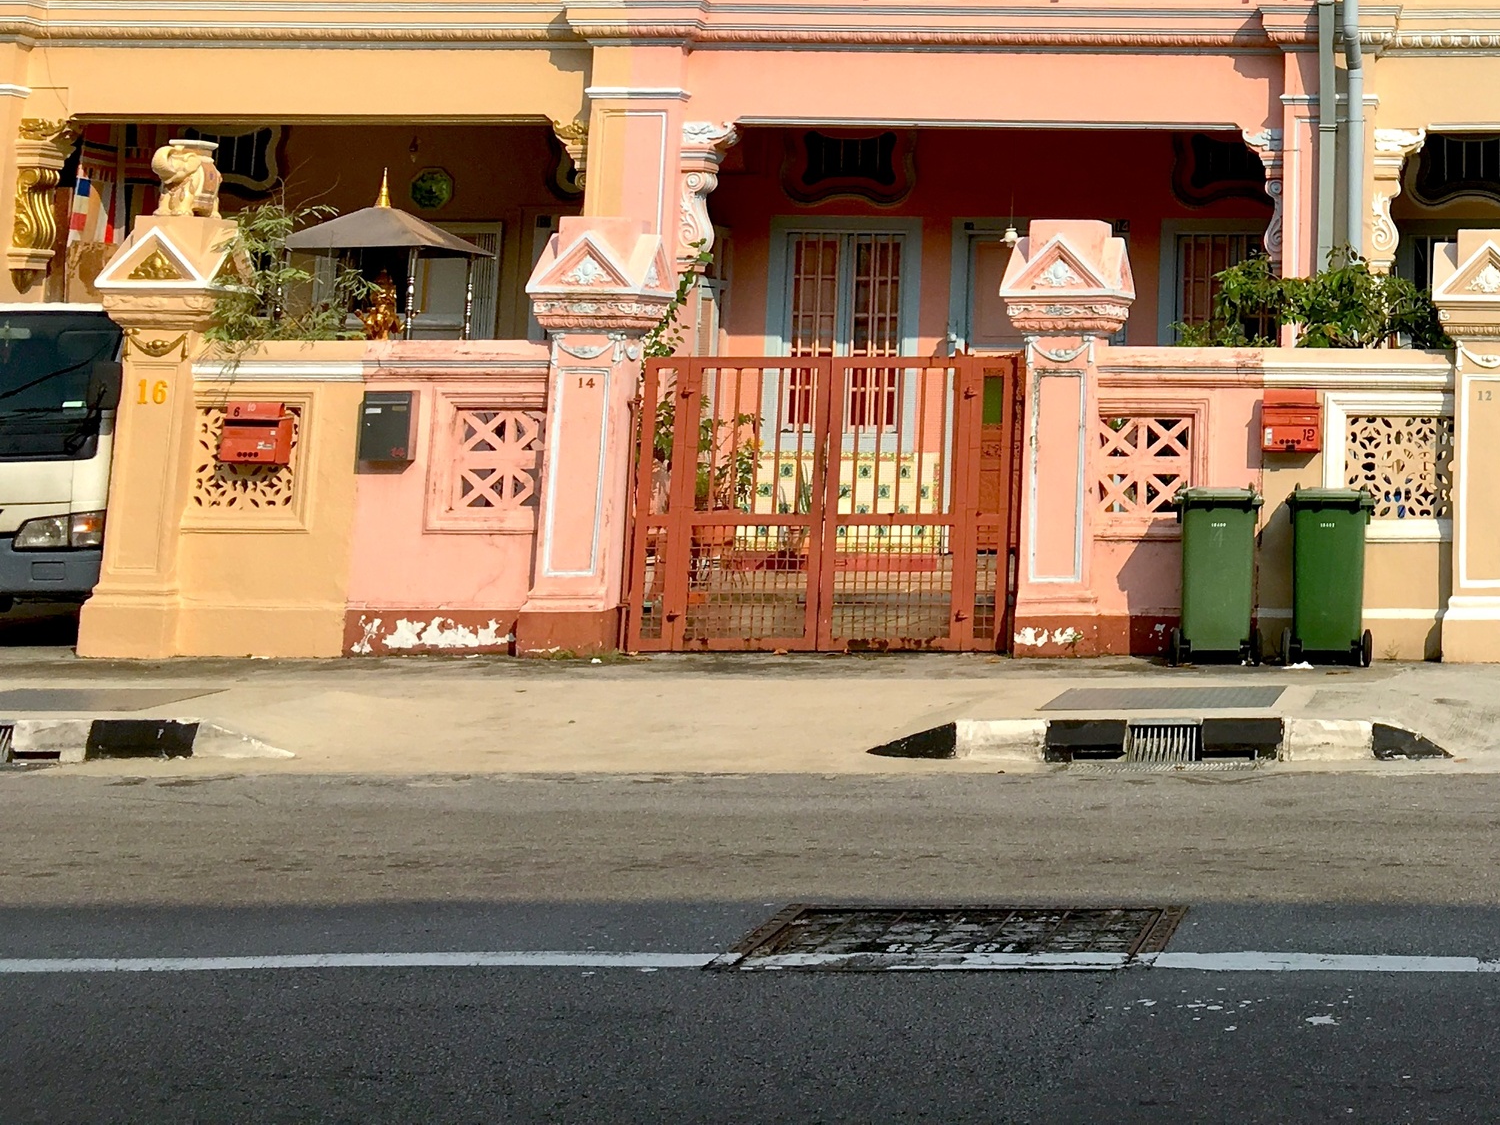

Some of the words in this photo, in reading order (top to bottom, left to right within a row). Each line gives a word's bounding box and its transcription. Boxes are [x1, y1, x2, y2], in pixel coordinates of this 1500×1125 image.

[578, 377, 596, 389] 14
[137, 378, 168, 405] 16
[1477, 390, 1493, 401] 12
[1302, 428, 1316, 442] 12
